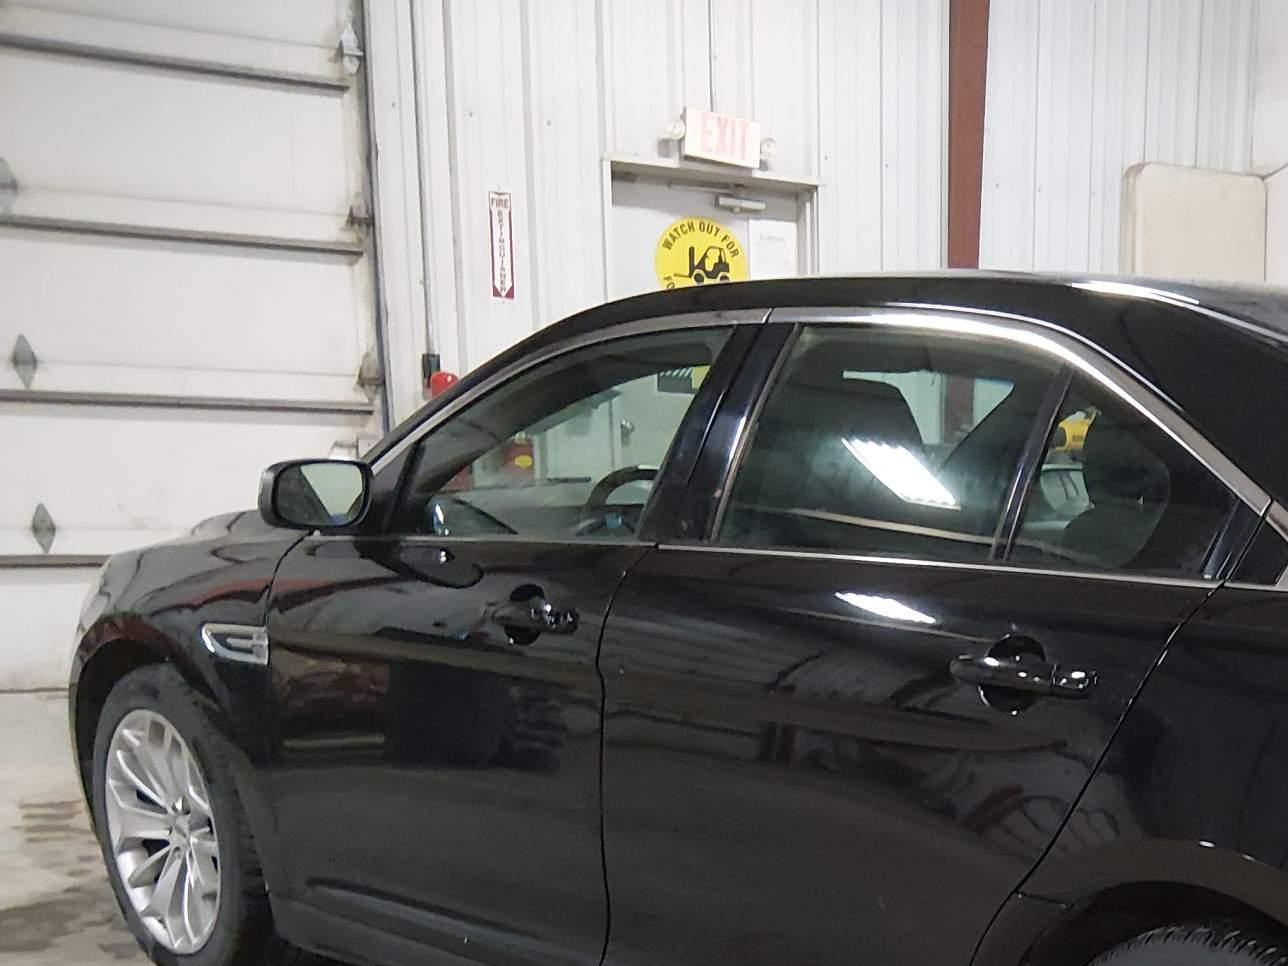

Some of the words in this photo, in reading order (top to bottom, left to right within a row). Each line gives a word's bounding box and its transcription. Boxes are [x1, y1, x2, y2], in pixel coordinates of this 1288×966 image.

[701, 112, 751, 161] EXIT
[491, 197, 509, 208] FIRE
[662, 220, 696, 251] WATCH
[698, 221, 721, 238] OUT
[720, 234, 740, 259] FOR
